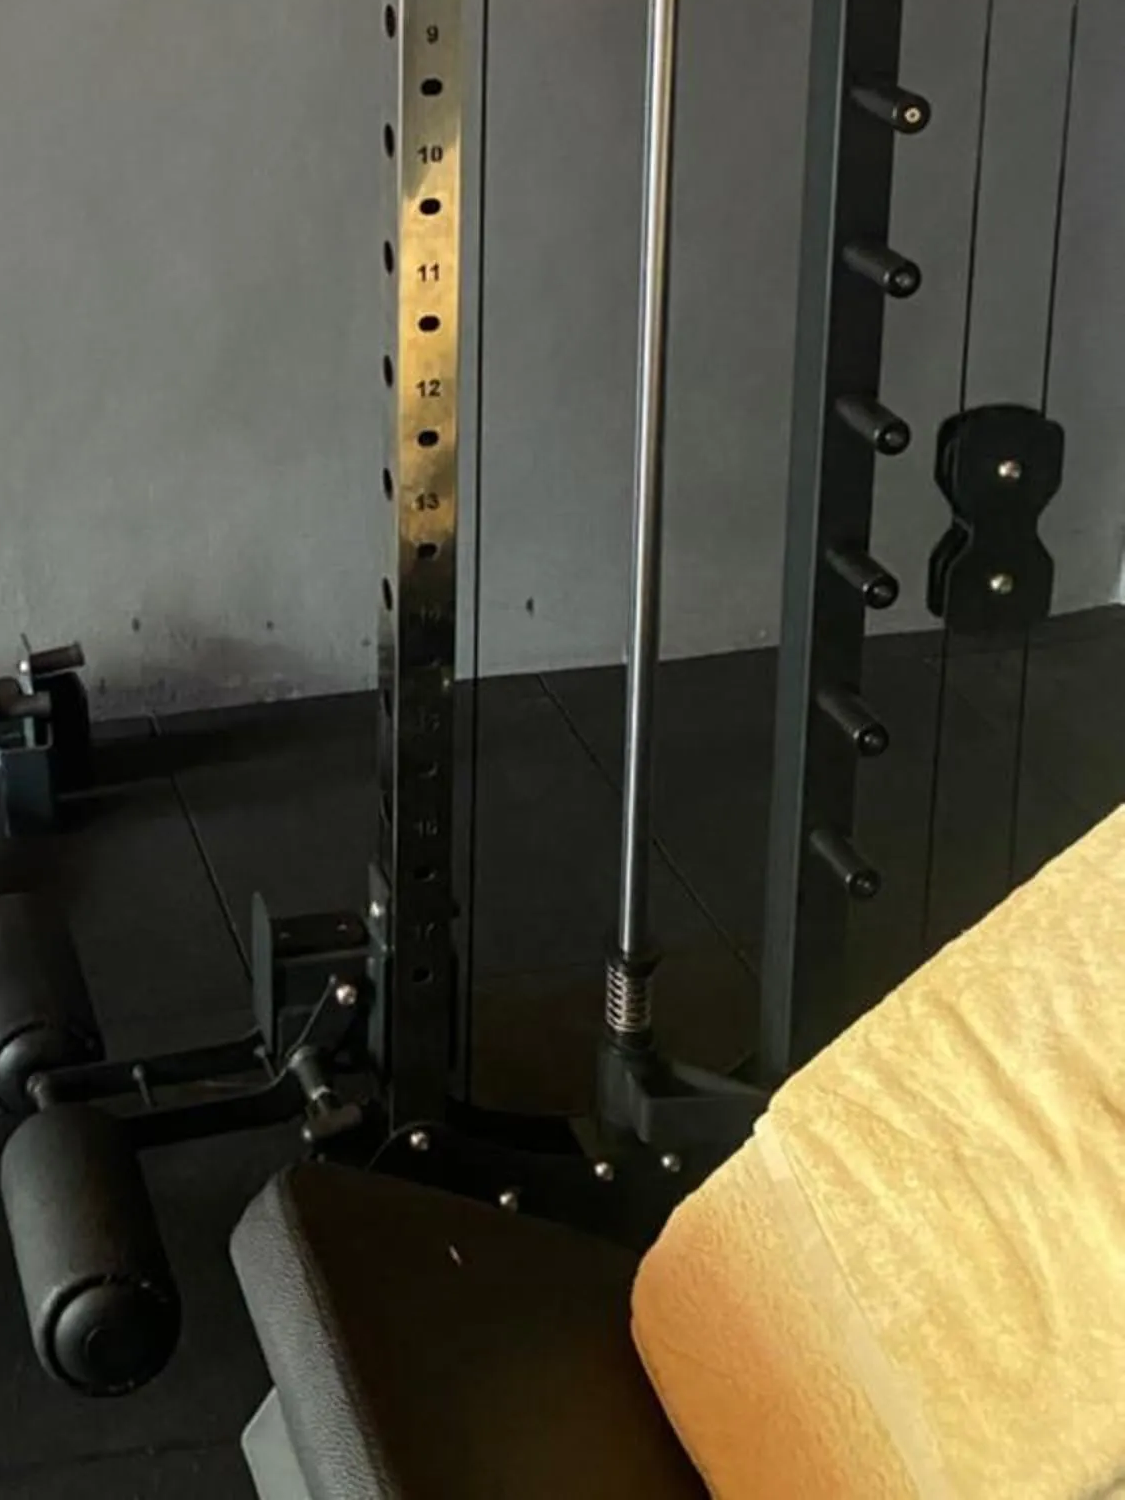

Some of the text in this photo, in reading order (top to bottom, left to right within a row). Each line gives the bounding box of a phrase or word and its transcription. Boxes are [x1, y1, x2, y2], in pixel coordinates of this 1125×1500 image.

[426, 24, 440, 45] 9
[417, 144, 444, 164] 10
[416, 263, 441, 283] 11
[416, 379, 442, 398] 12
[415, 493, 441, 512] 13
